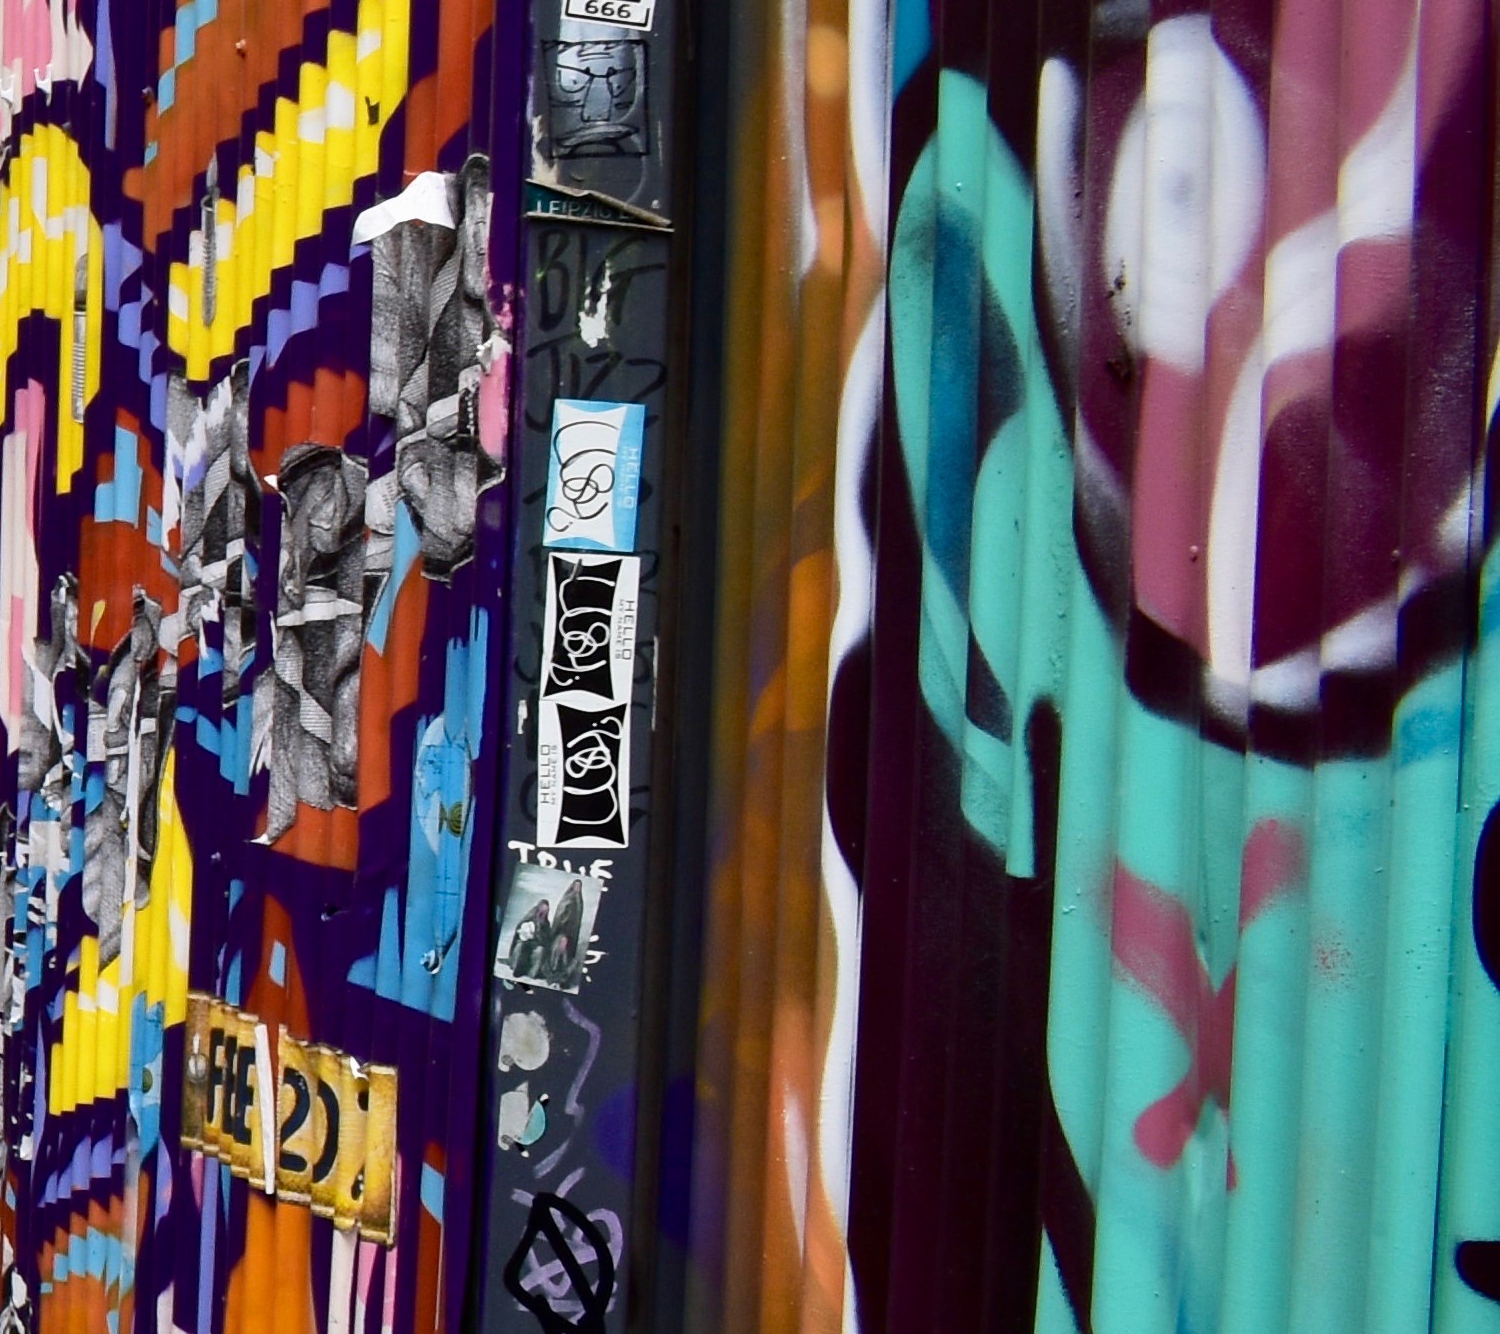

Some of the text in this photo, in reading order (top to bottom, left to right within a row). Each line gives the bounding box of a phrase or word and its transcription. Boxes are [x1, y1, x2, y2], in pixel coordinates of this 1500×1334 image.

[584, 0, 632, 19] 666
[622, 446, 639, 510] HELLO
[620, 599, 635, 661] HELLO
[540, 743, 551, 805] HELLO
